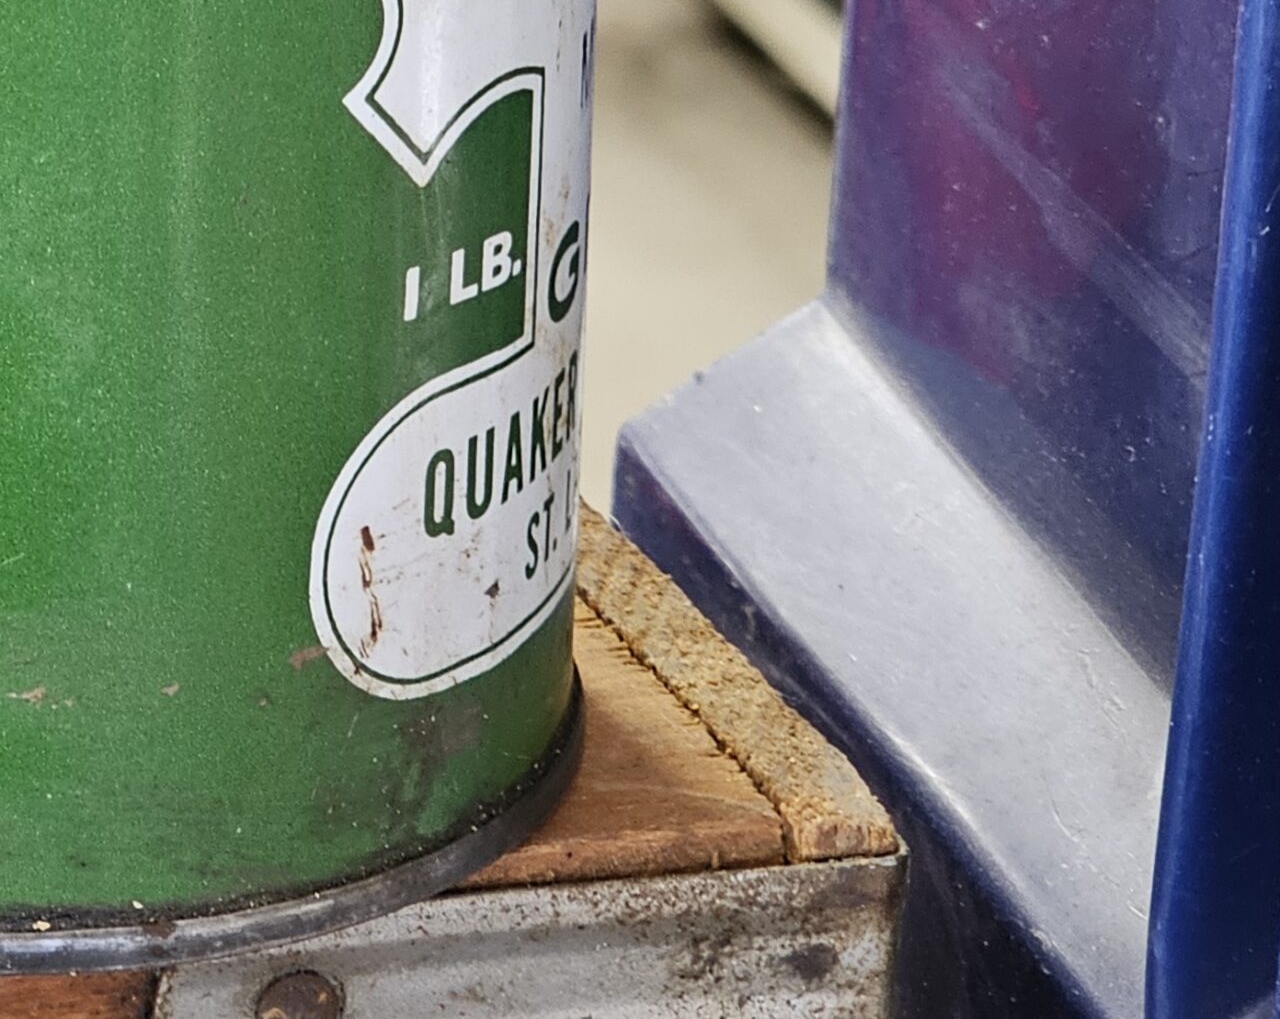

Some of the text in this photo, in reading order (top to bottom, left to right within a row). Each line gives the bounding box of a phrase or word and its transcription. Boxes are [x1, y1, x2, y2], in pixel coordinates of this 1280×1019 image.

[450, 230, 522, 306] LB.
[423, 350, 578, 538] QUAKER
[525, 492, 556, 580] ST.
